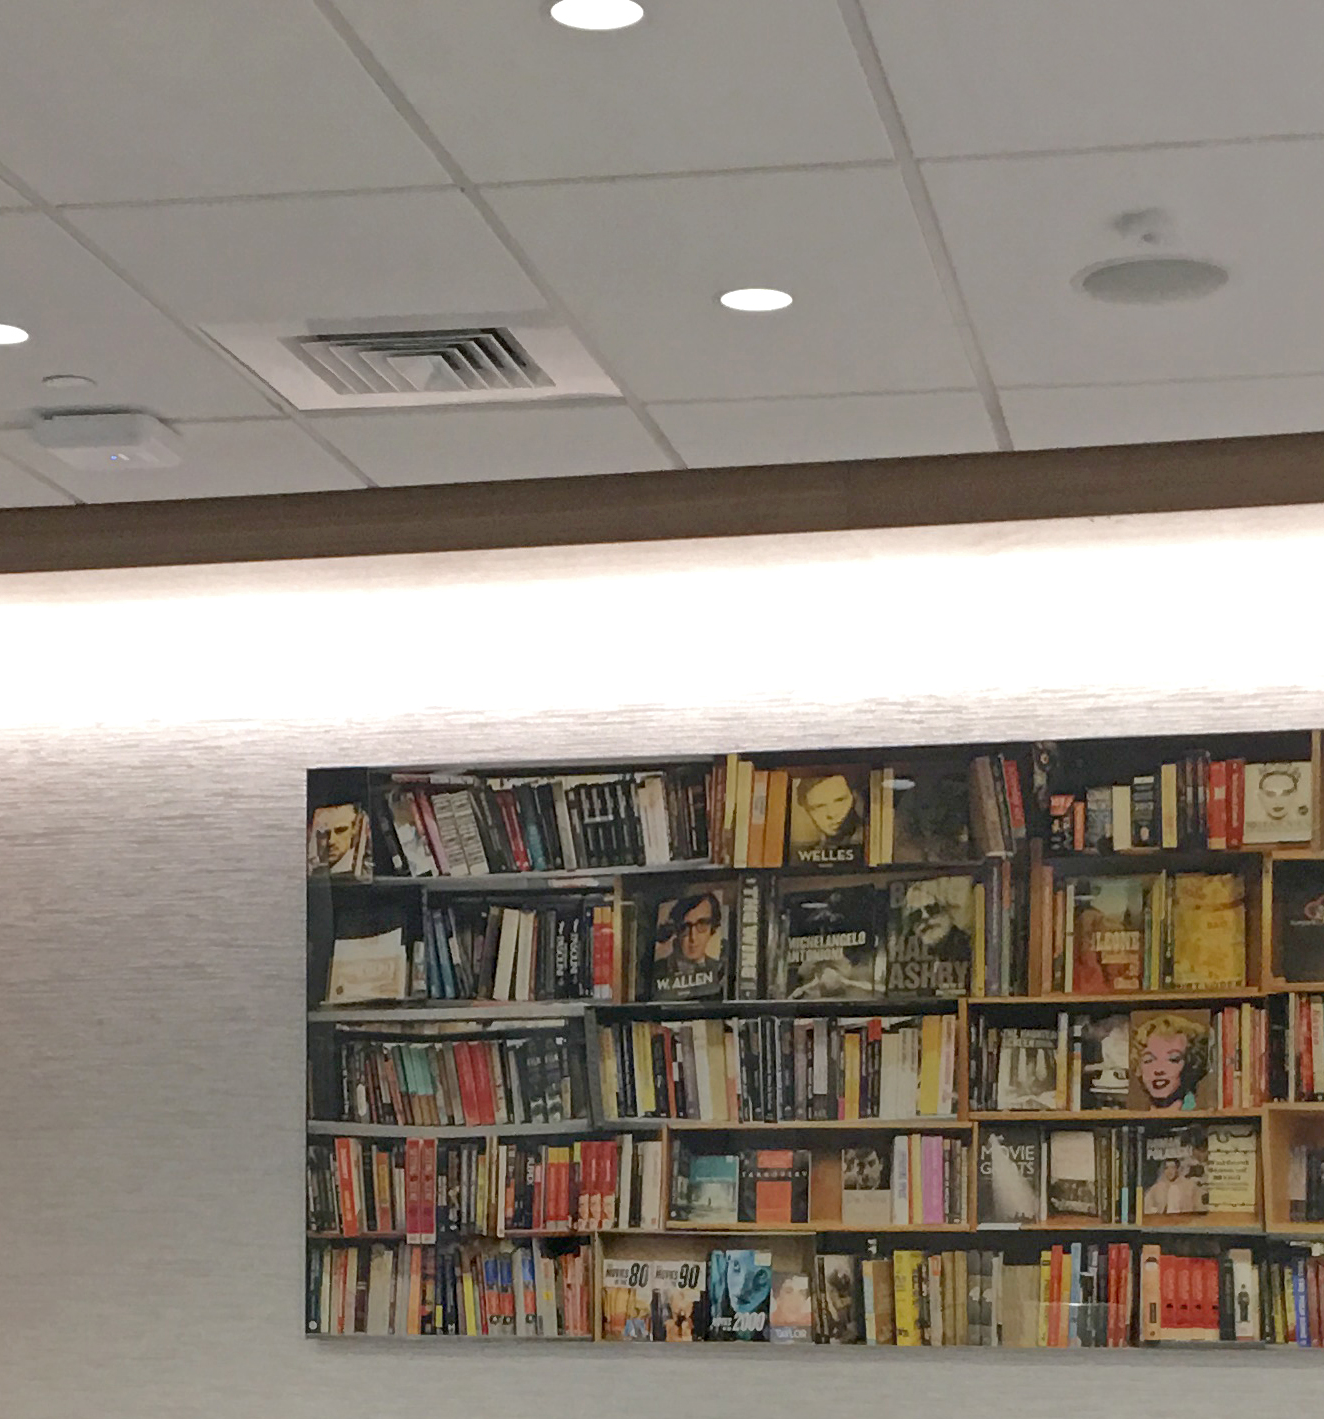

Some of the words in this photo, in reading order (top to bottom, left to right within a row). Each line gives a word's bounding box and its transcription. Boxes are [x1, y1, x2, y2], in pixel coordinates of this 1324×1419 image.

[798, 849, 854, 861] WELLES
[741, 886, 759, 923] THE
[787, 931, 866, 949] MICHELANGELO
[740, 925, 758, 979] WIRE
[657, 978, 670, 990] W.
[672, 971, 713, 989] ALLEN
[888, 961, 969, 989] ASHBY
[980, 1162, 1035, 1175] GTS
[628, 1262, 649, 1288] 80
[678, 1263, 701, 1289] 90
[732, 1312, 765, 1332] 2000
